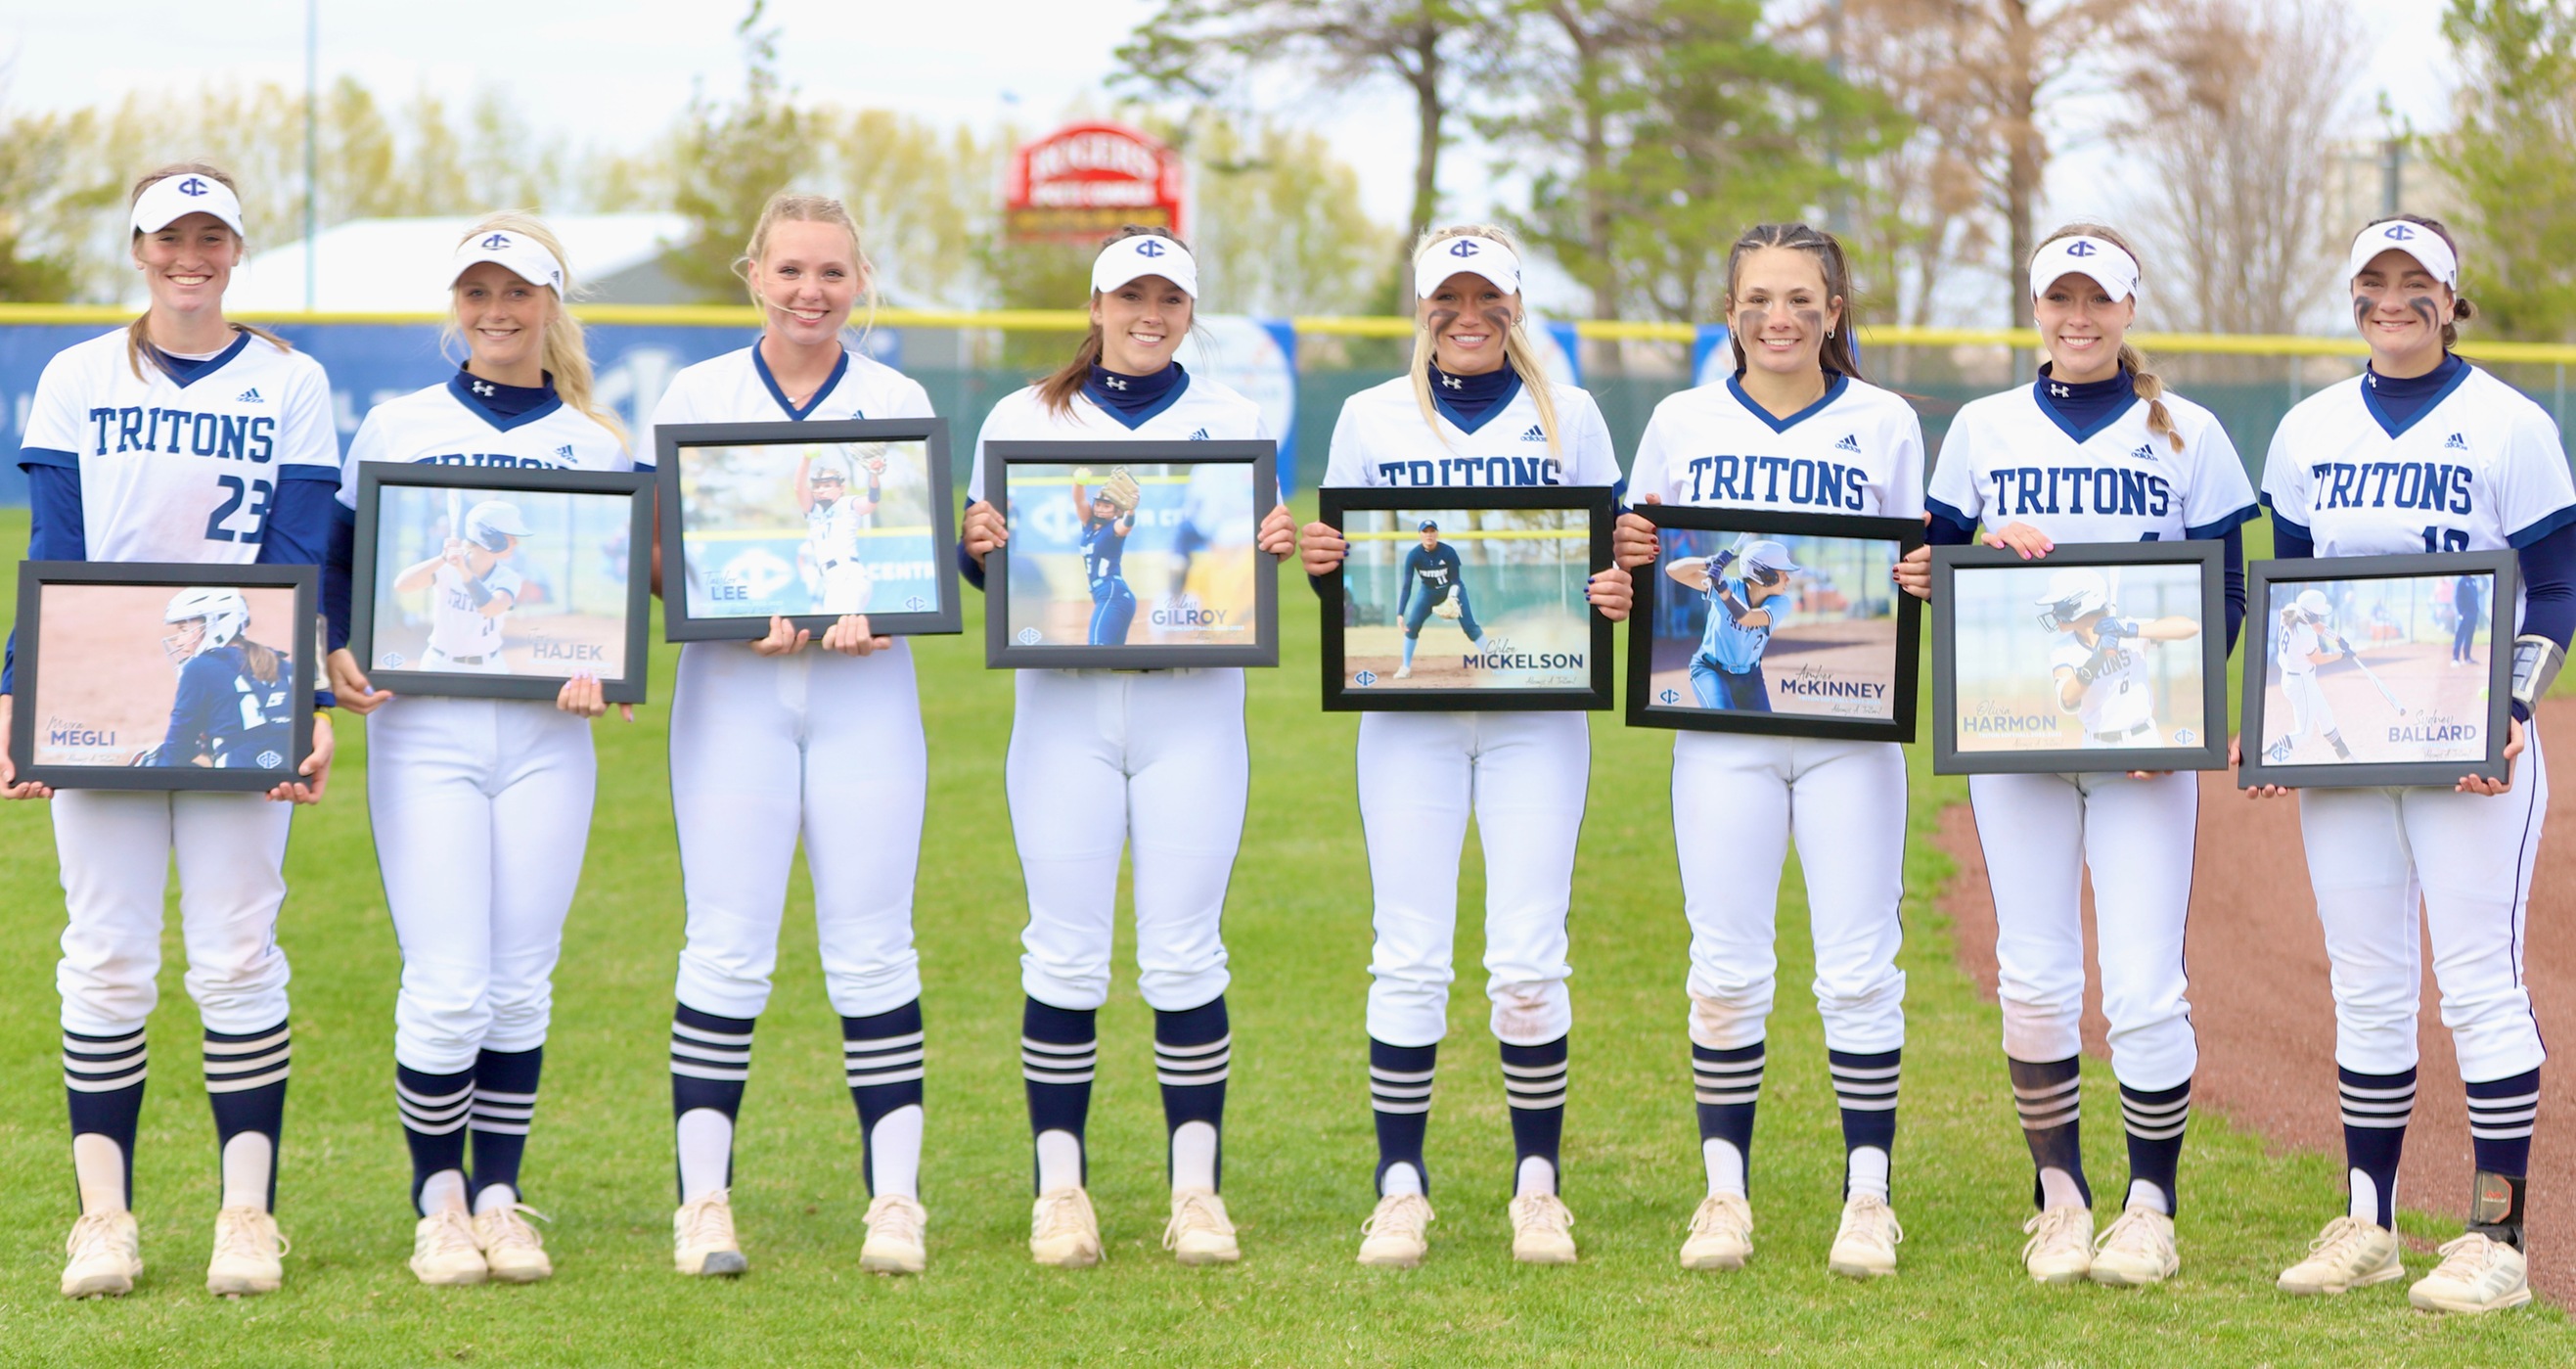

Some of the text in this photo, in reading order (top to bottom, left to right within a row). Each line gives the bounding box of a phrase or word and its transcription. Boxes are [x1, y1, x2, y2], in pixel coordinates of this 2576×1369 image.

[89, 406, 275, 464] TRITONS
[1689, 455, 1869, 511] TRITONS
[1990, 467, 2170, 517] TRITONS
[2312, 462, 2473, 516] TRITONS
[204, 475, 273, 544] 23
[710, 585, 748, 601] LEE
[1152, 609, 1228, 625] GILROY
[533, 643, 604, 661] HAJEK
[1485, 638, 1516, 655] Chloe
[1463, 654, 1583, 669] MICKELSON
[1795, 663, 1834, 681] Amber
[1781, 679, 1886, 699] McKINNEY
[1976, 701, 2011, 716] Olivia
[1964, 715, 2056, 732] HARMON
[2414, 708, 2455, 731] Sydney
[51, 730, 115, 747] MEGLI
[2388, 725, 2476, 743] BALLARD
